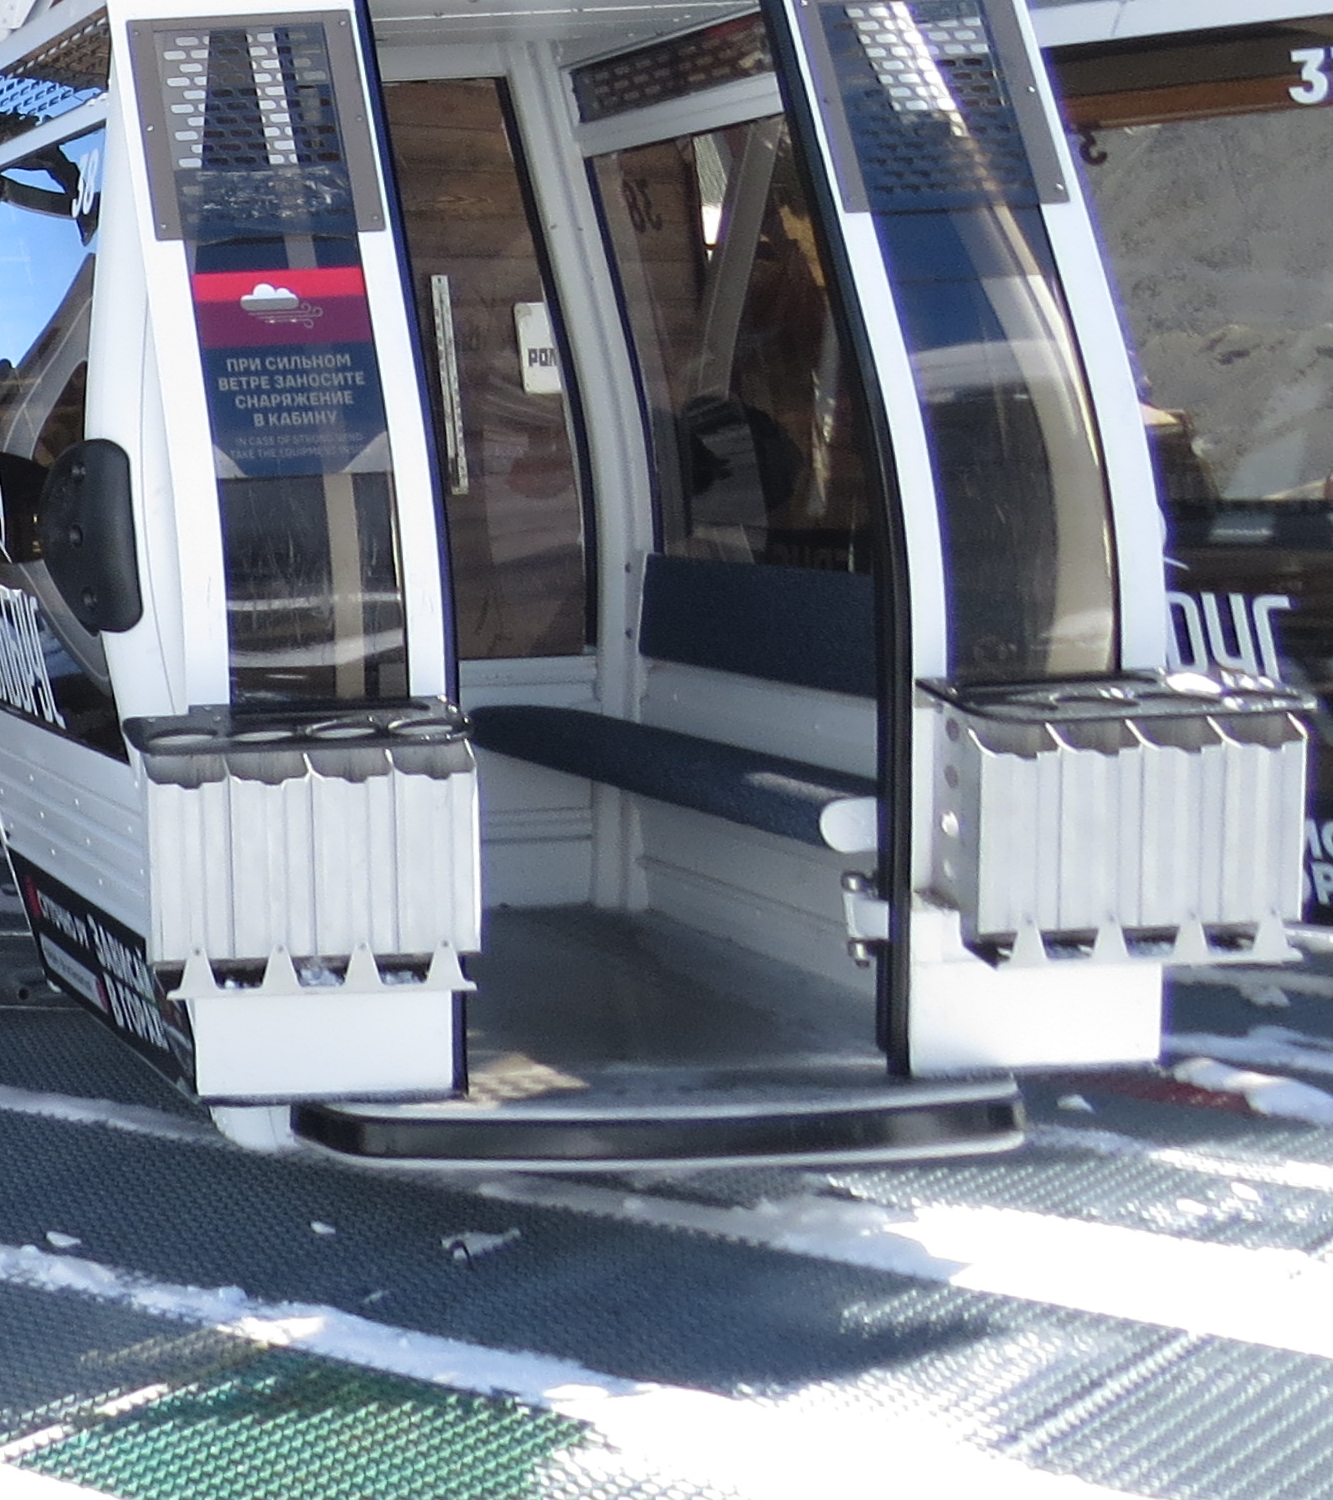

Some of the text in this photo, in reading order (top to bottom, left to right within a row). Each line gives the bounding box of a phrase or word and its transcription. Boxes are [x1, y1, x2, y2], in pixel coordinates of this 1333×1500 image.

[226, 353, 351, 373] ПРИ СИЛЬНОМ
[218, 371, 366, 391] ВЕТРЕ ЗАНОСИТЕ
[235, 390, 354, 409] СНАРЯЖЕНИЕ
[253, 410, 337, 428] В КАБИНУ
